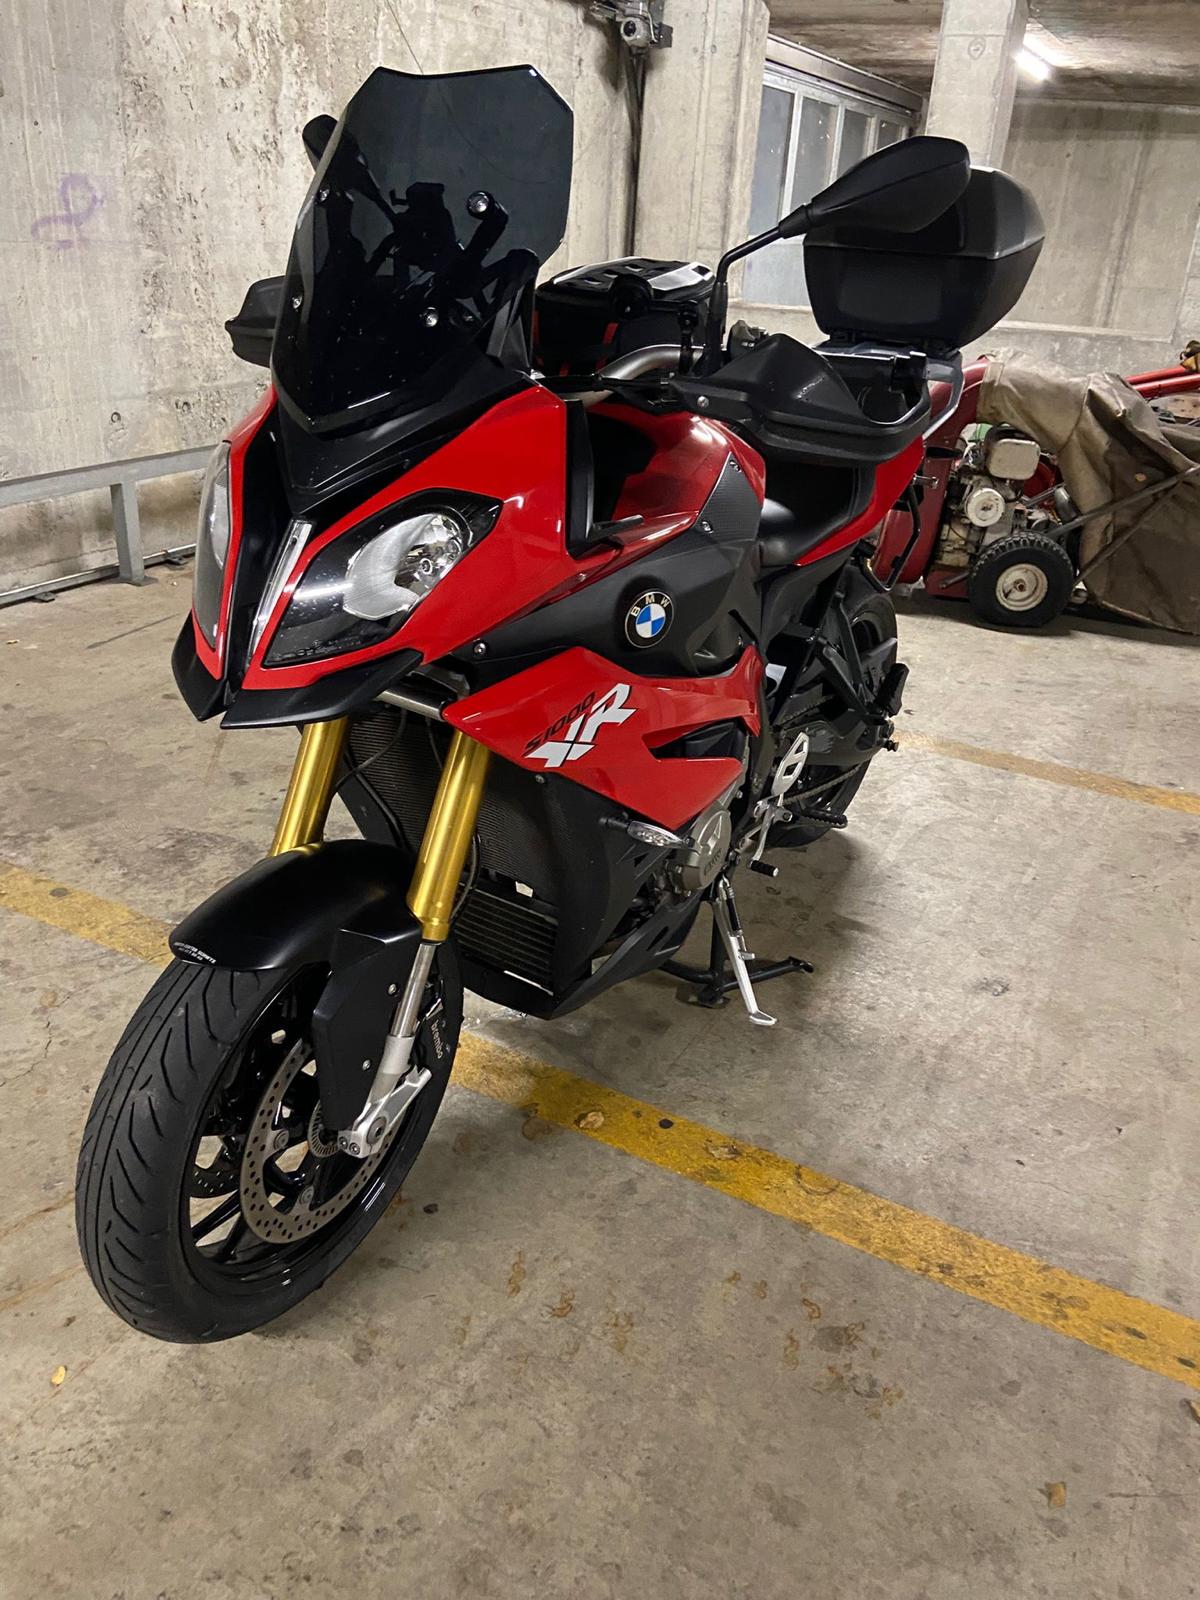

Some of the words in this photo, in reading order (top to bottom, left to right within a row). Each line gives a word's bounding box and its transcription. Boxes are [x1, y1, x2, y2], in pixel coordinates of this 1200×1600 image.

[630, 594, 670, 617] BMW
[523, 682, 638, 768] XR
[525, 691, 596, 750] S1000
[431, 1019, 444, 1059] brembo
